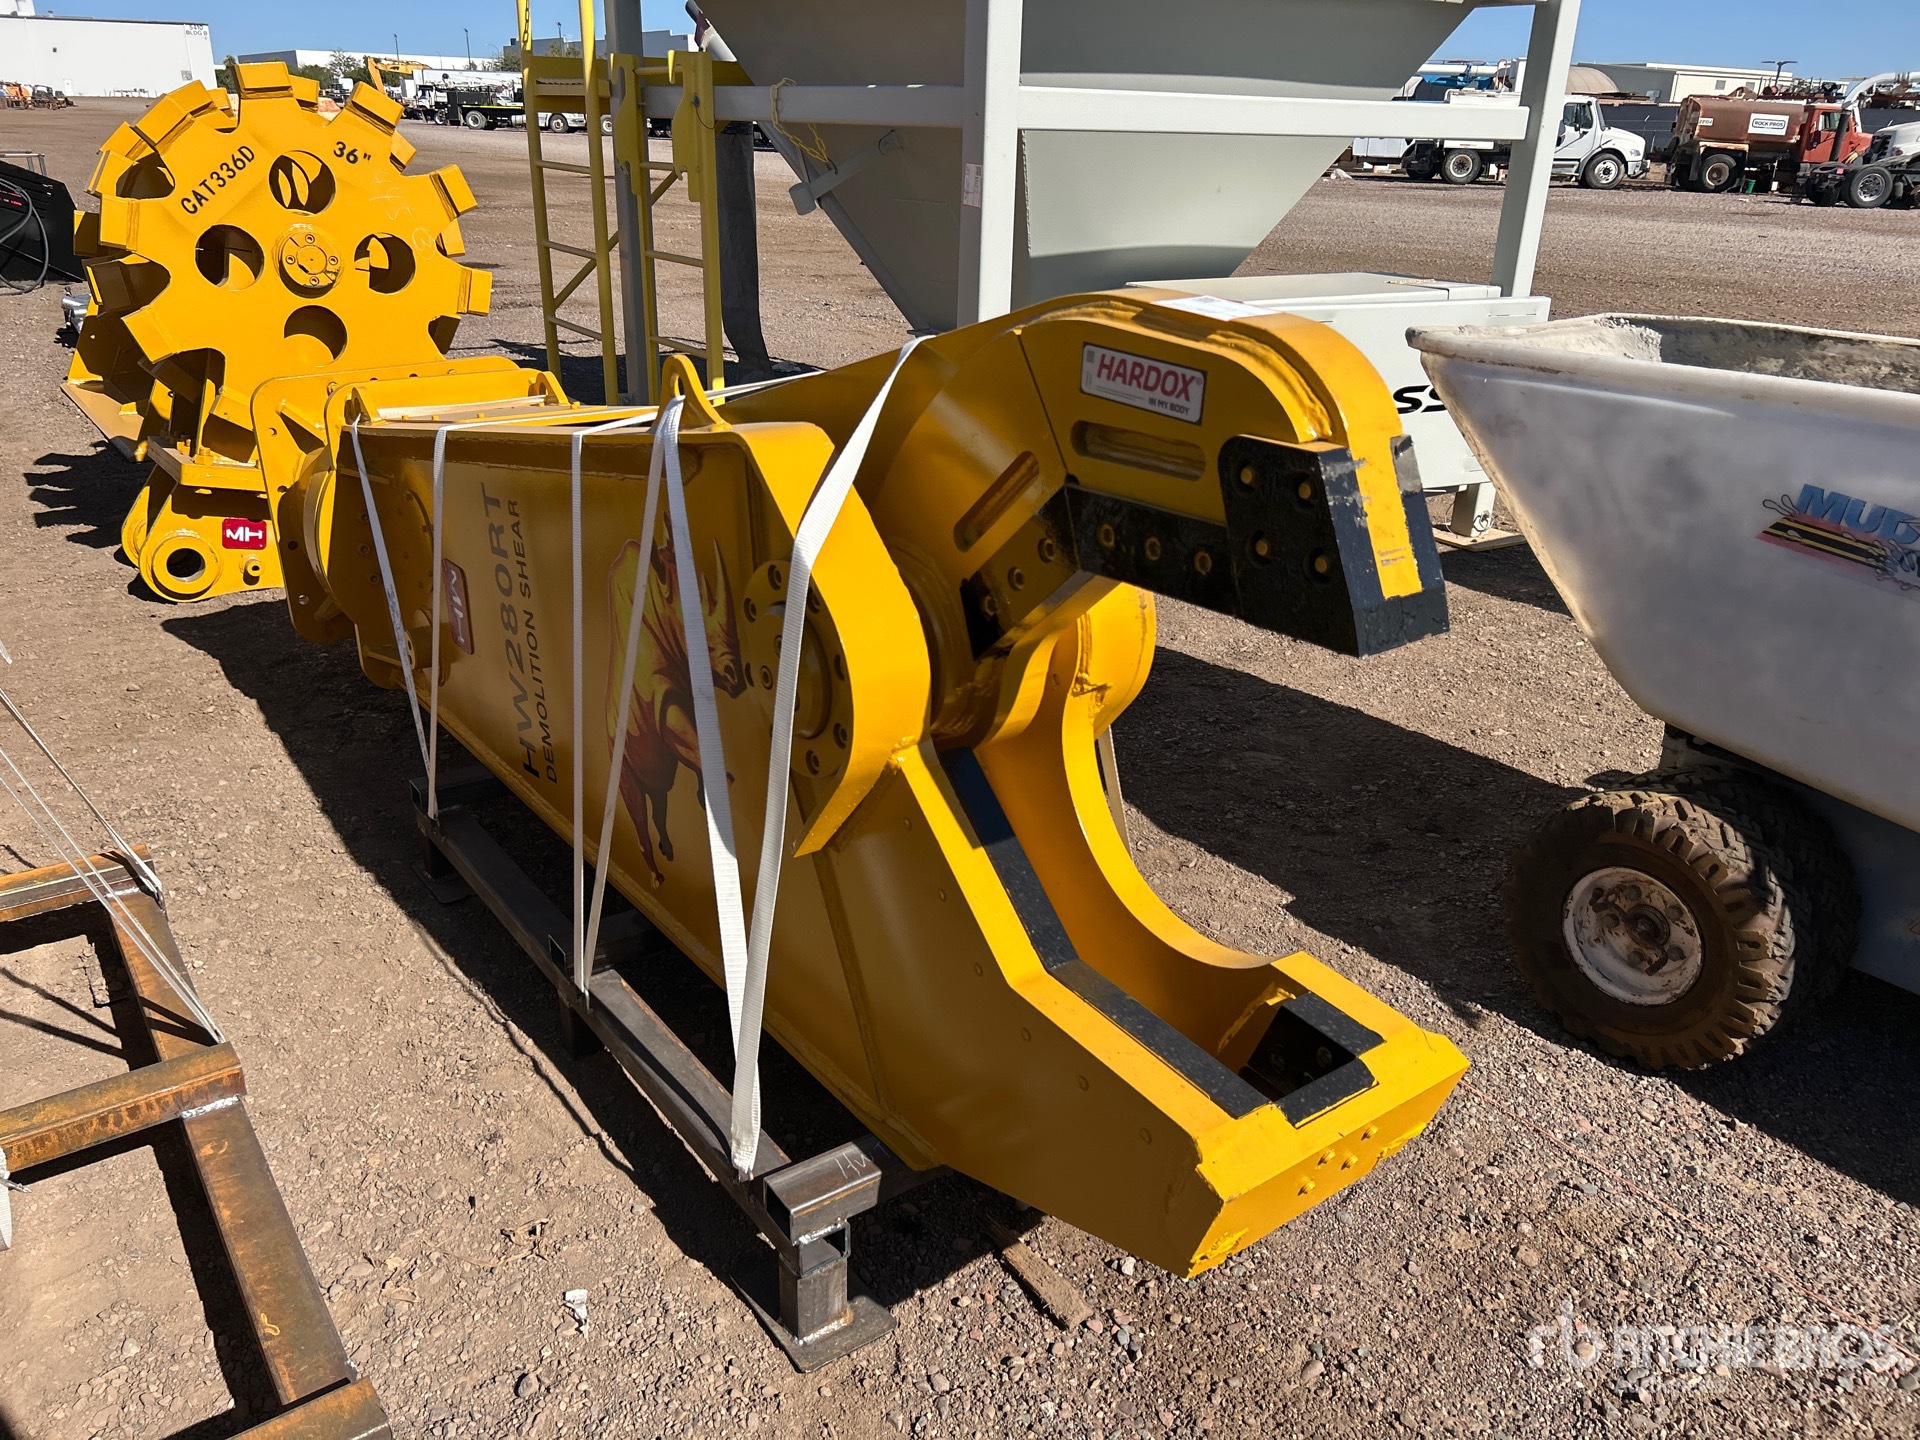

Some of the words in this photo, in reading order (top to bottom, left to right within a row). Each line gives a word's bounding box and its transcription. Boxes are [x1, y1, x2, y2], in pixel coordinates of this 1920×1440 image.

[180, 145, 255, 214] CAT336D
[1148, 397, 1157, 407] IN
[1157, 399, 1169, 410] MY
[1169, 402, 1190, 415] BODY
[507, 499, 531, 600] SHEAR
[481, 482, 540, 779] HW280RT
[523, 609, 558, 784] DEMOLITION
